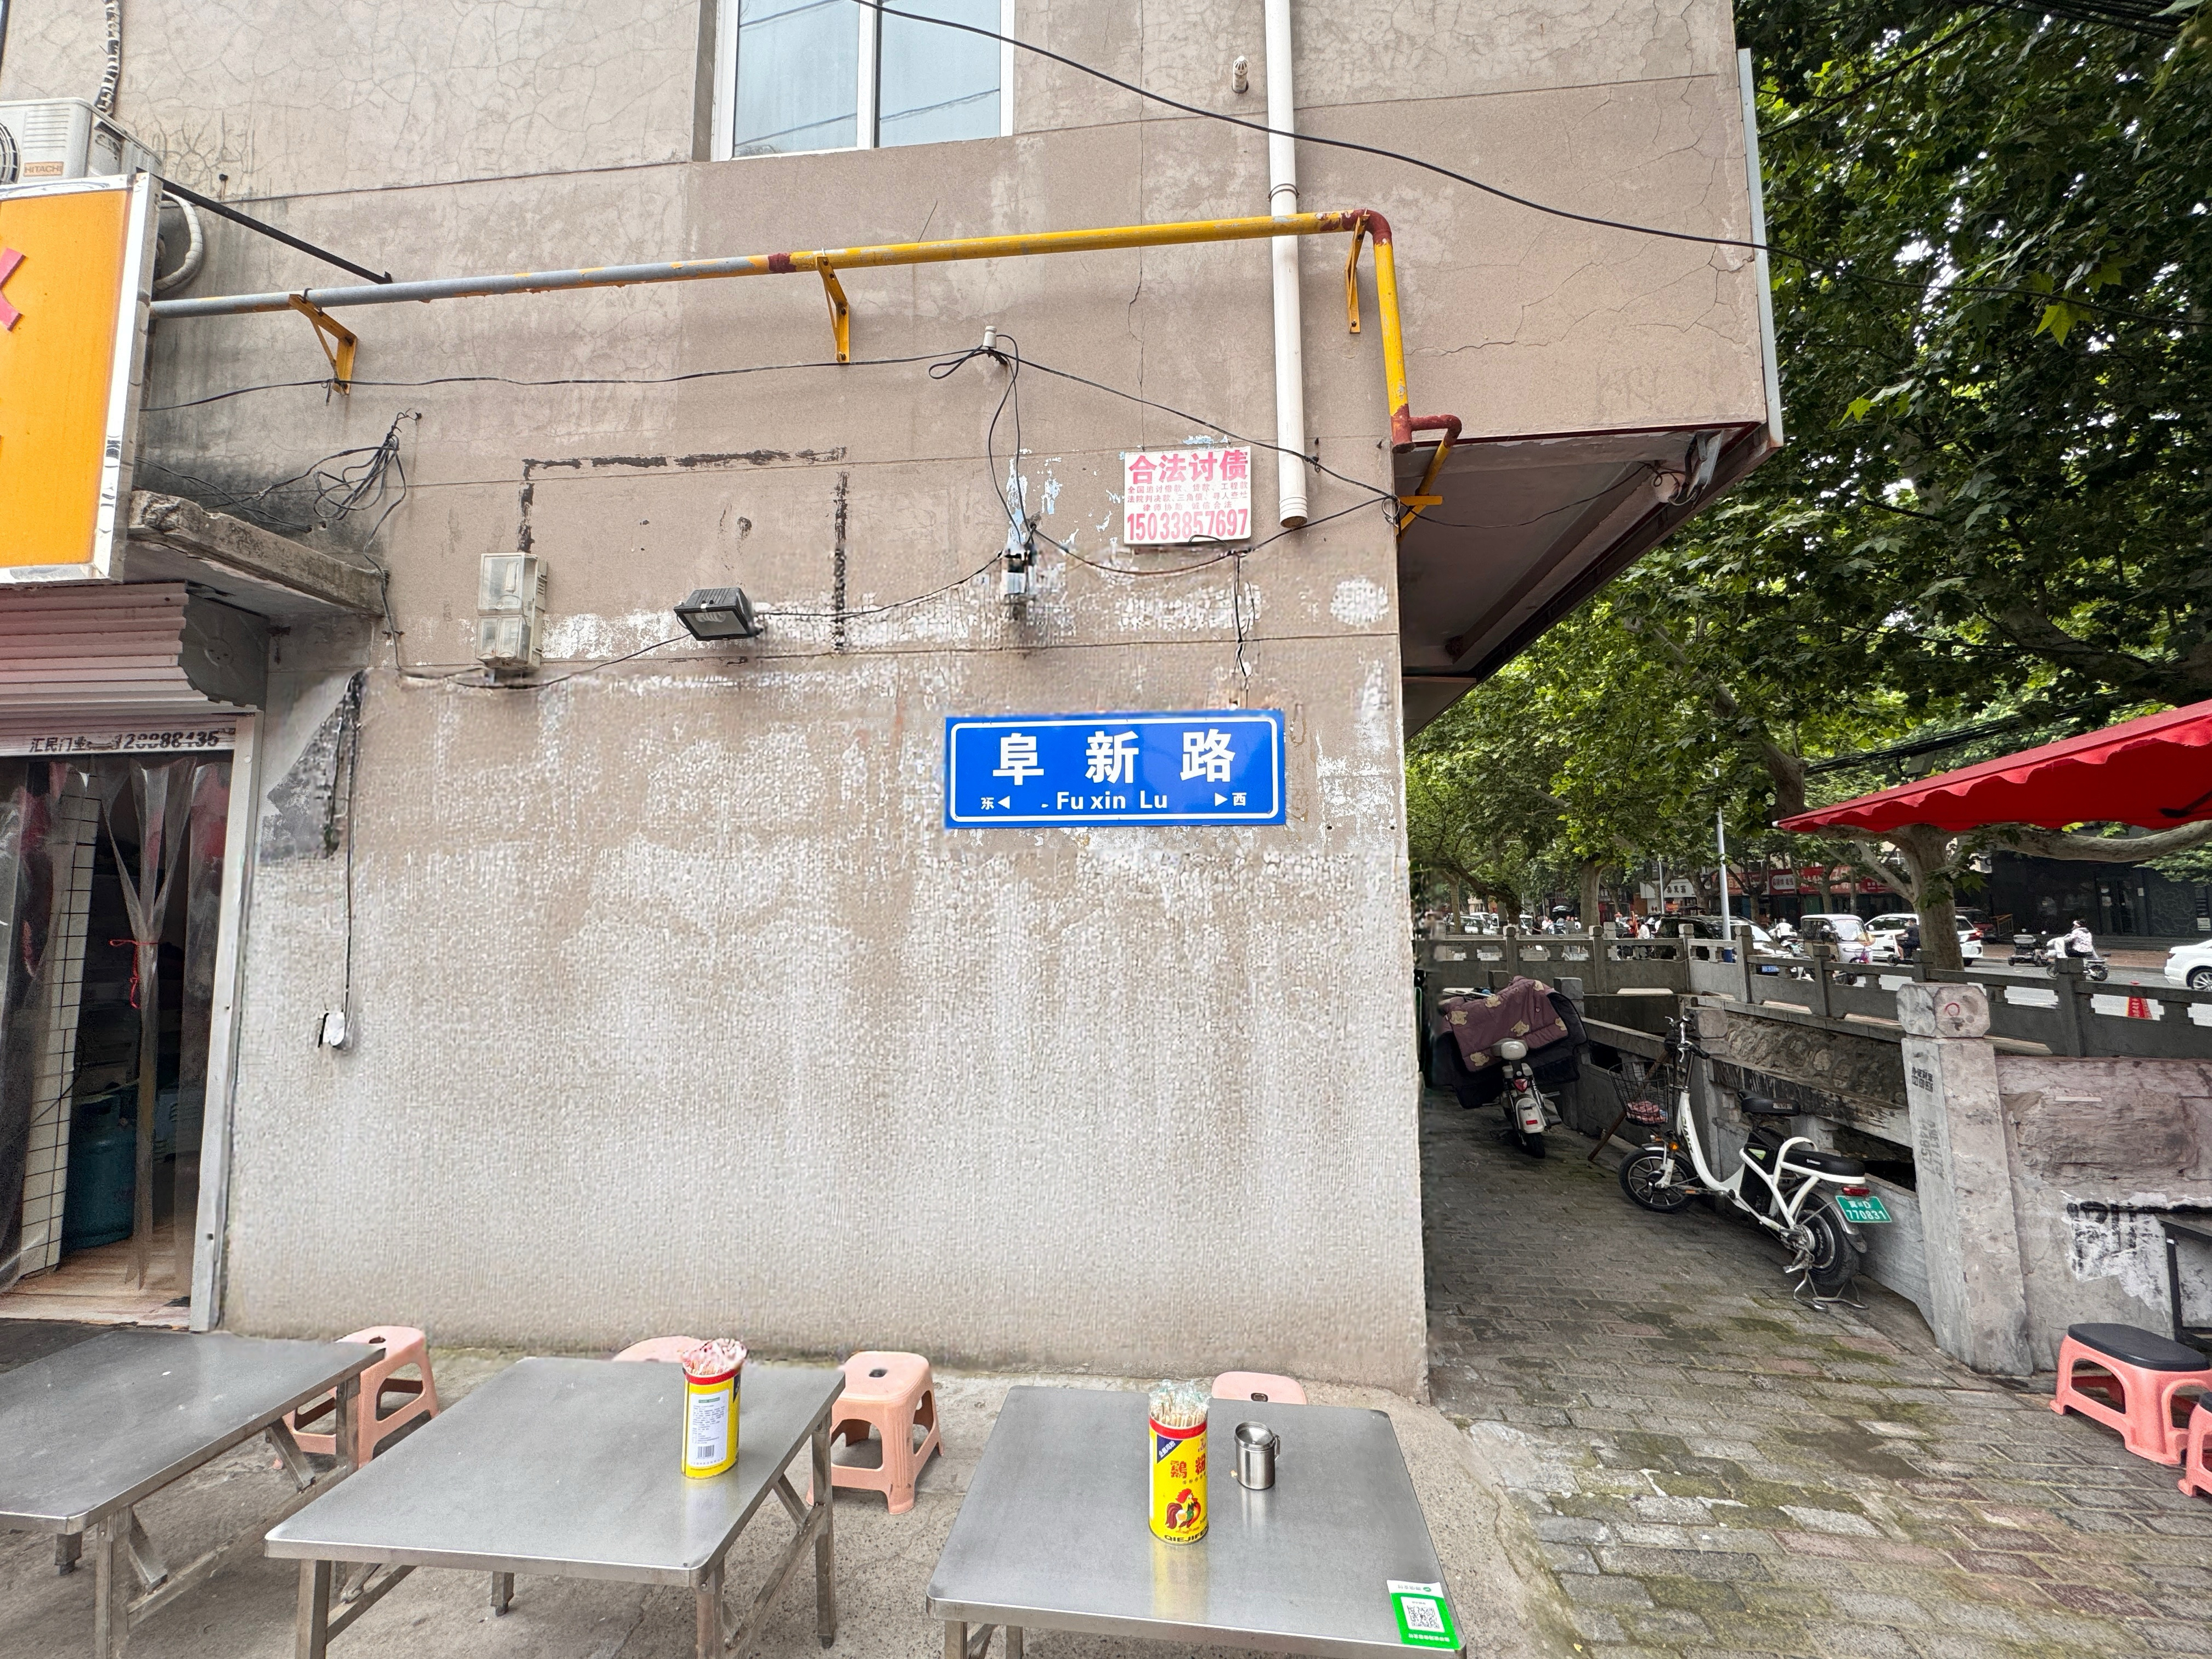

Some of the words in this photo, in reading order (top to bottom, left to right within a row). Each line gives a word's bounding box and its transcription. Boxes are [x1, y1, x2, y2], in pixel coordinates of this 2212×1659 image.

[1129, 450, 1248, 484] 合法讨债
[1127, 509, 1248, 541] 15033857697
[992, 728, 1235, 786] 阜新路
[980, 797, 995, 811] 东
[1140, 790, 1167, 809] Lu
[1233, 792, 1246, 807] 西
[1846, 1210, 1887, 1220] 770831
